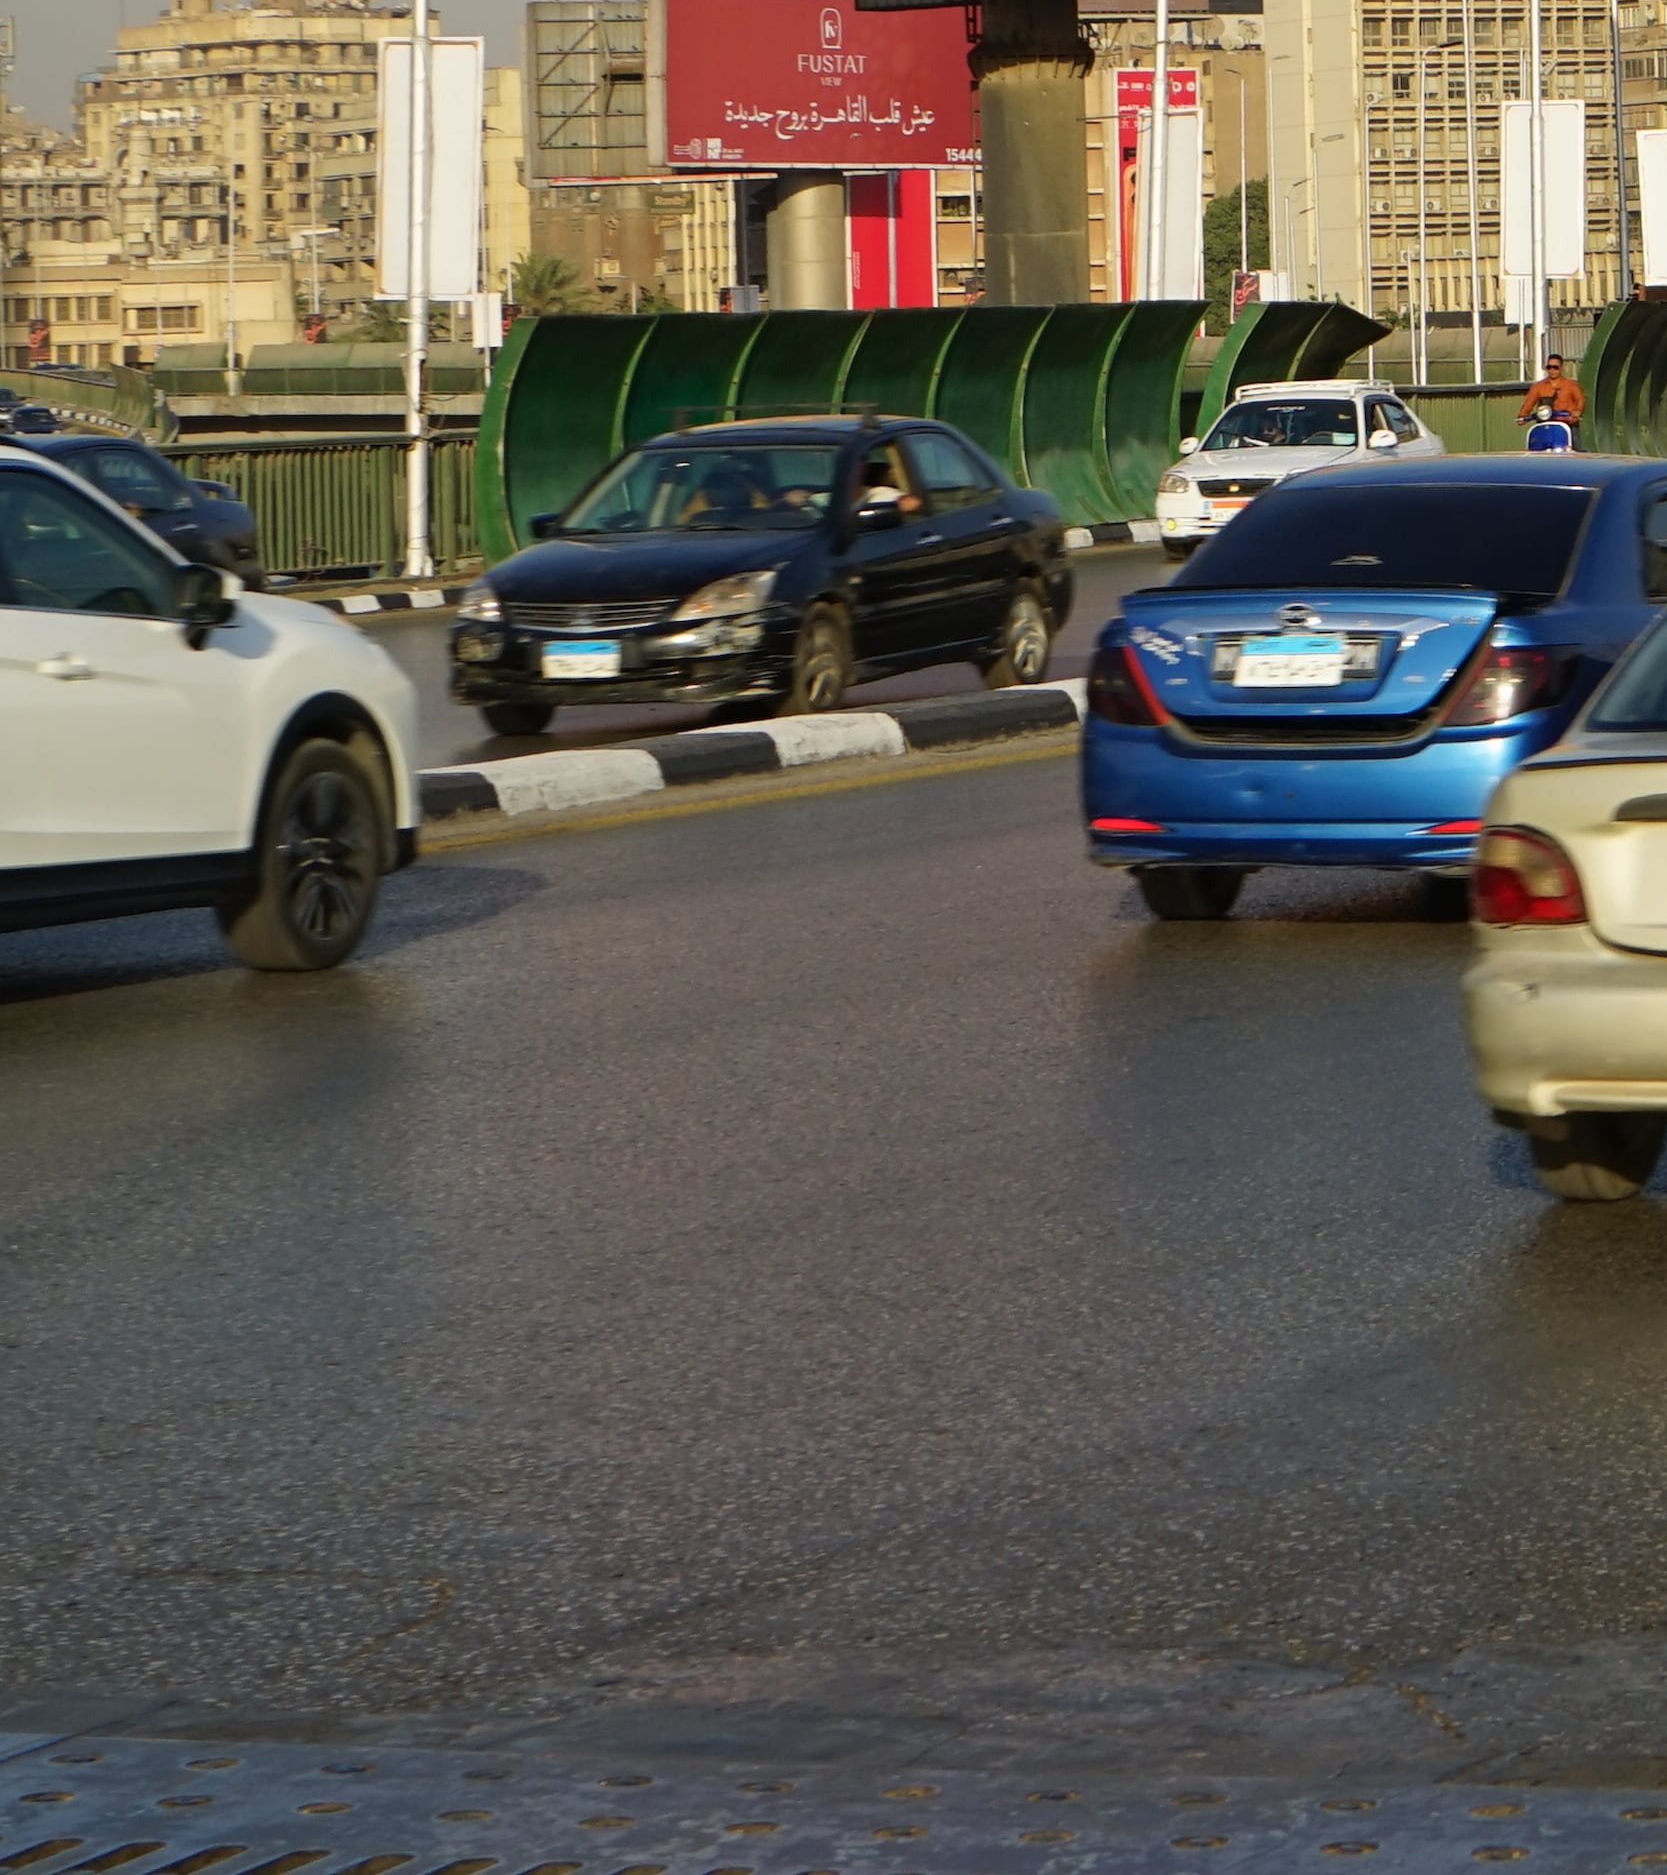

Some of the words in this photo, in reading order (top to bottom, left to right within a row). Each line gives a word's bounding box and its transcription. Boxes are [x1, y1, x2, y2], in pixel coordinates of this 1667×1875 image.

[797, 53, 867, 74] FUSTAT
[820, 76, 843, 87] VIEW
[724, 100, 775, 129] جديدة
[868, 97, 902, 132] قلب
[902, 104, 936, 136] عيش
